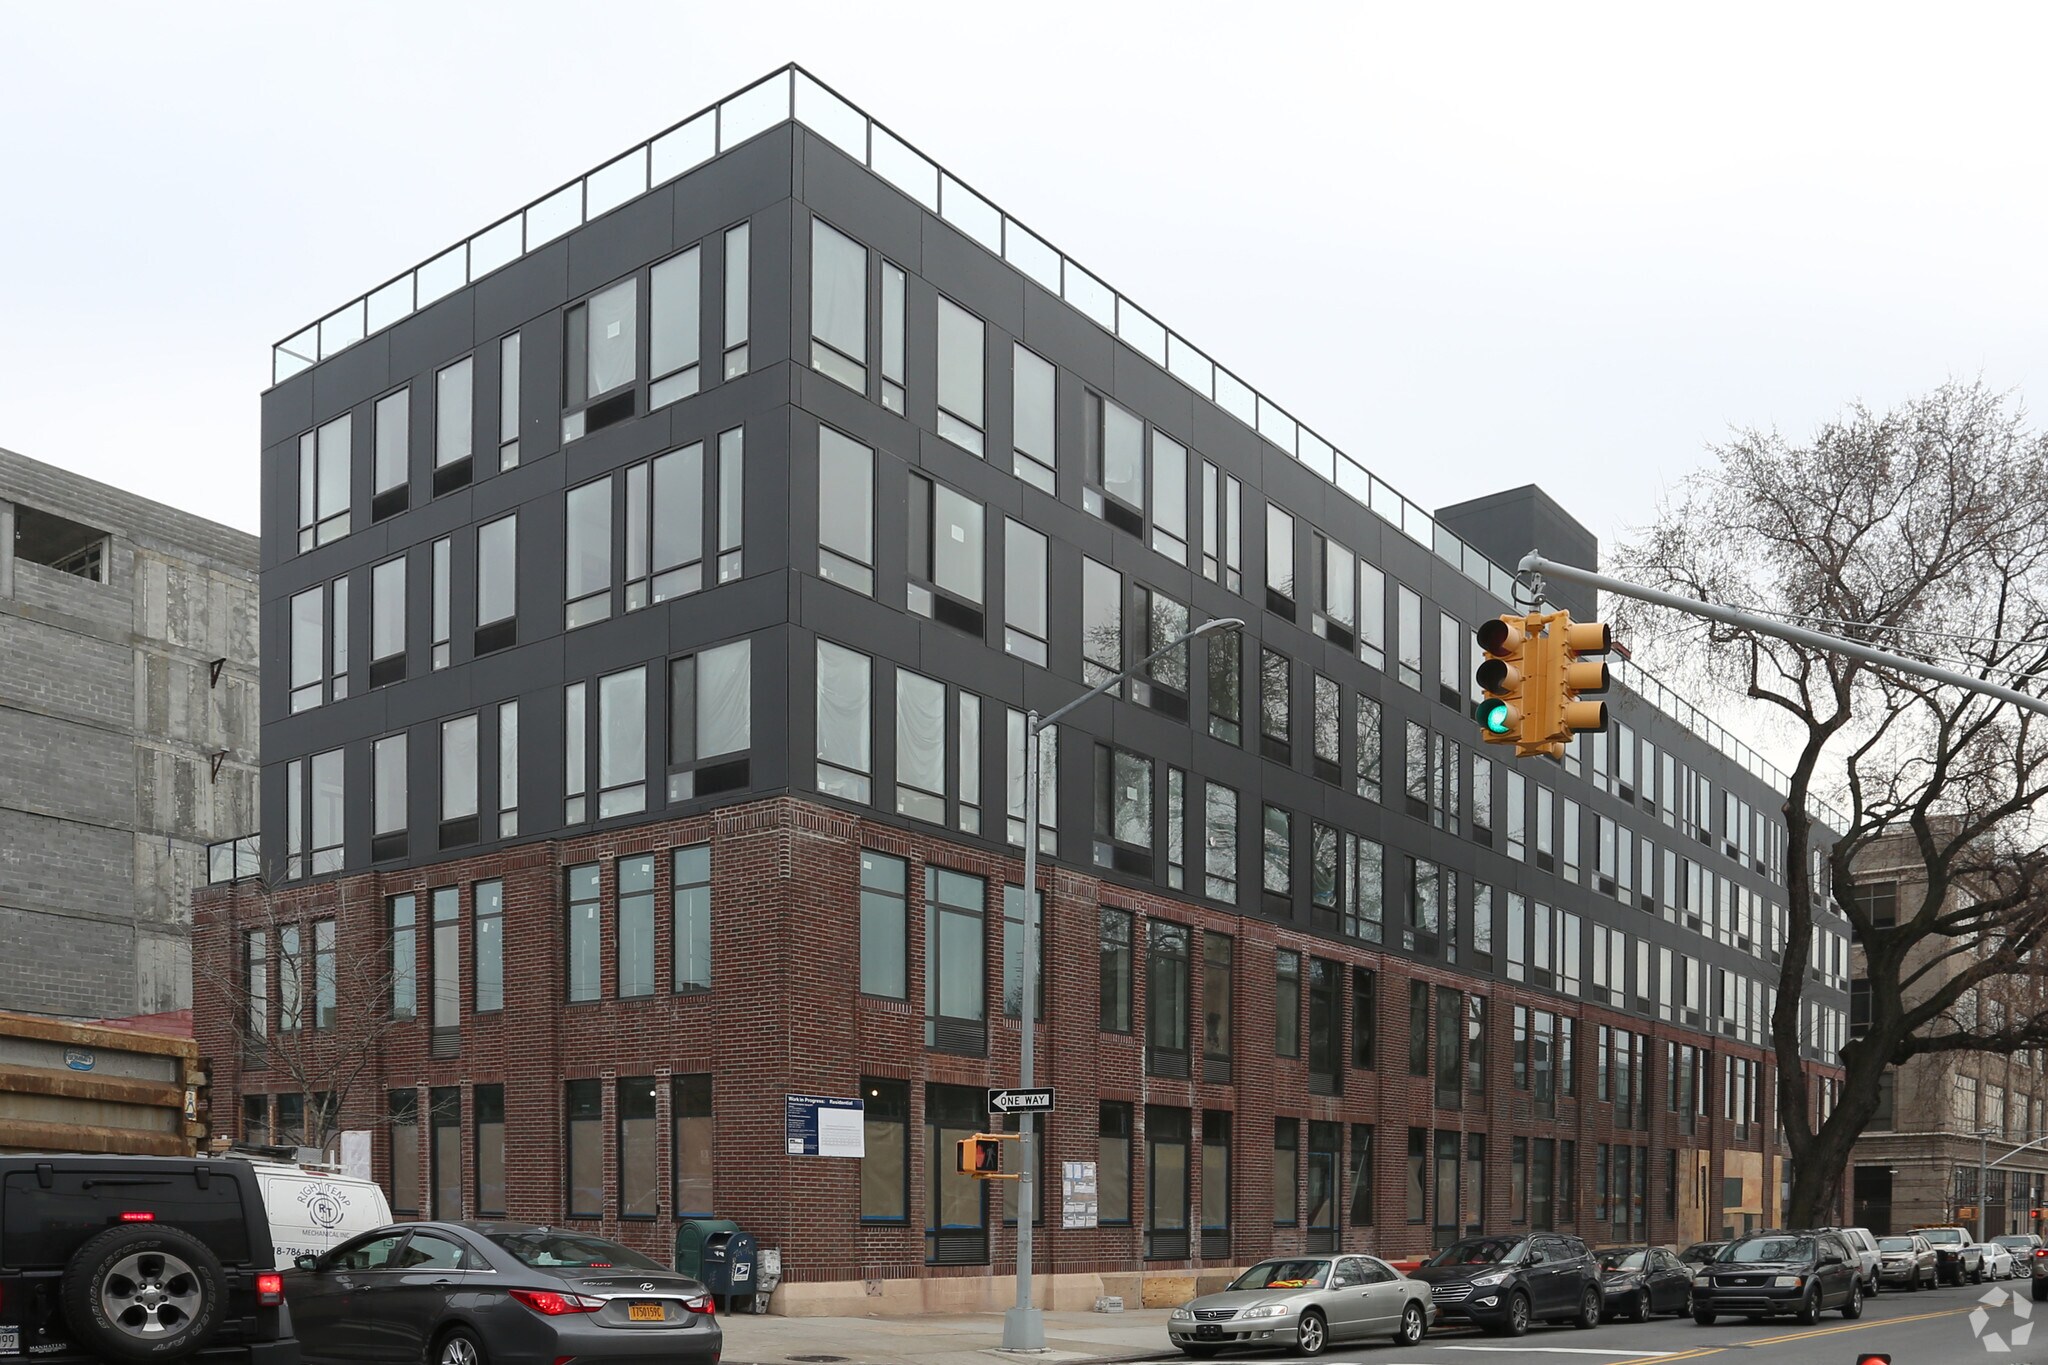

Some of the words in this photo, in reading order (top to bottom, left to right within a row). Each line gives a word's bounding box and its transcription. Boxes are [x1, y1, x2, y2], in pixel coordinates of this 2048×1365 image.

[1001, 1096, 1020, 1106] ONE
[1025, 1095, 1045, 1105] WAY
[296, 1182, 323, 1203] RIGHT
[325, 1184, 351, 1207] TEMP
[302, 1229, 339, 1238] MECHANICAL
[90, 1240, 161, 1329] BRIDGESTONE
[0, 1334, 15, 1348] 99
[29, 1342, 67, 1350] MANHATTAN
